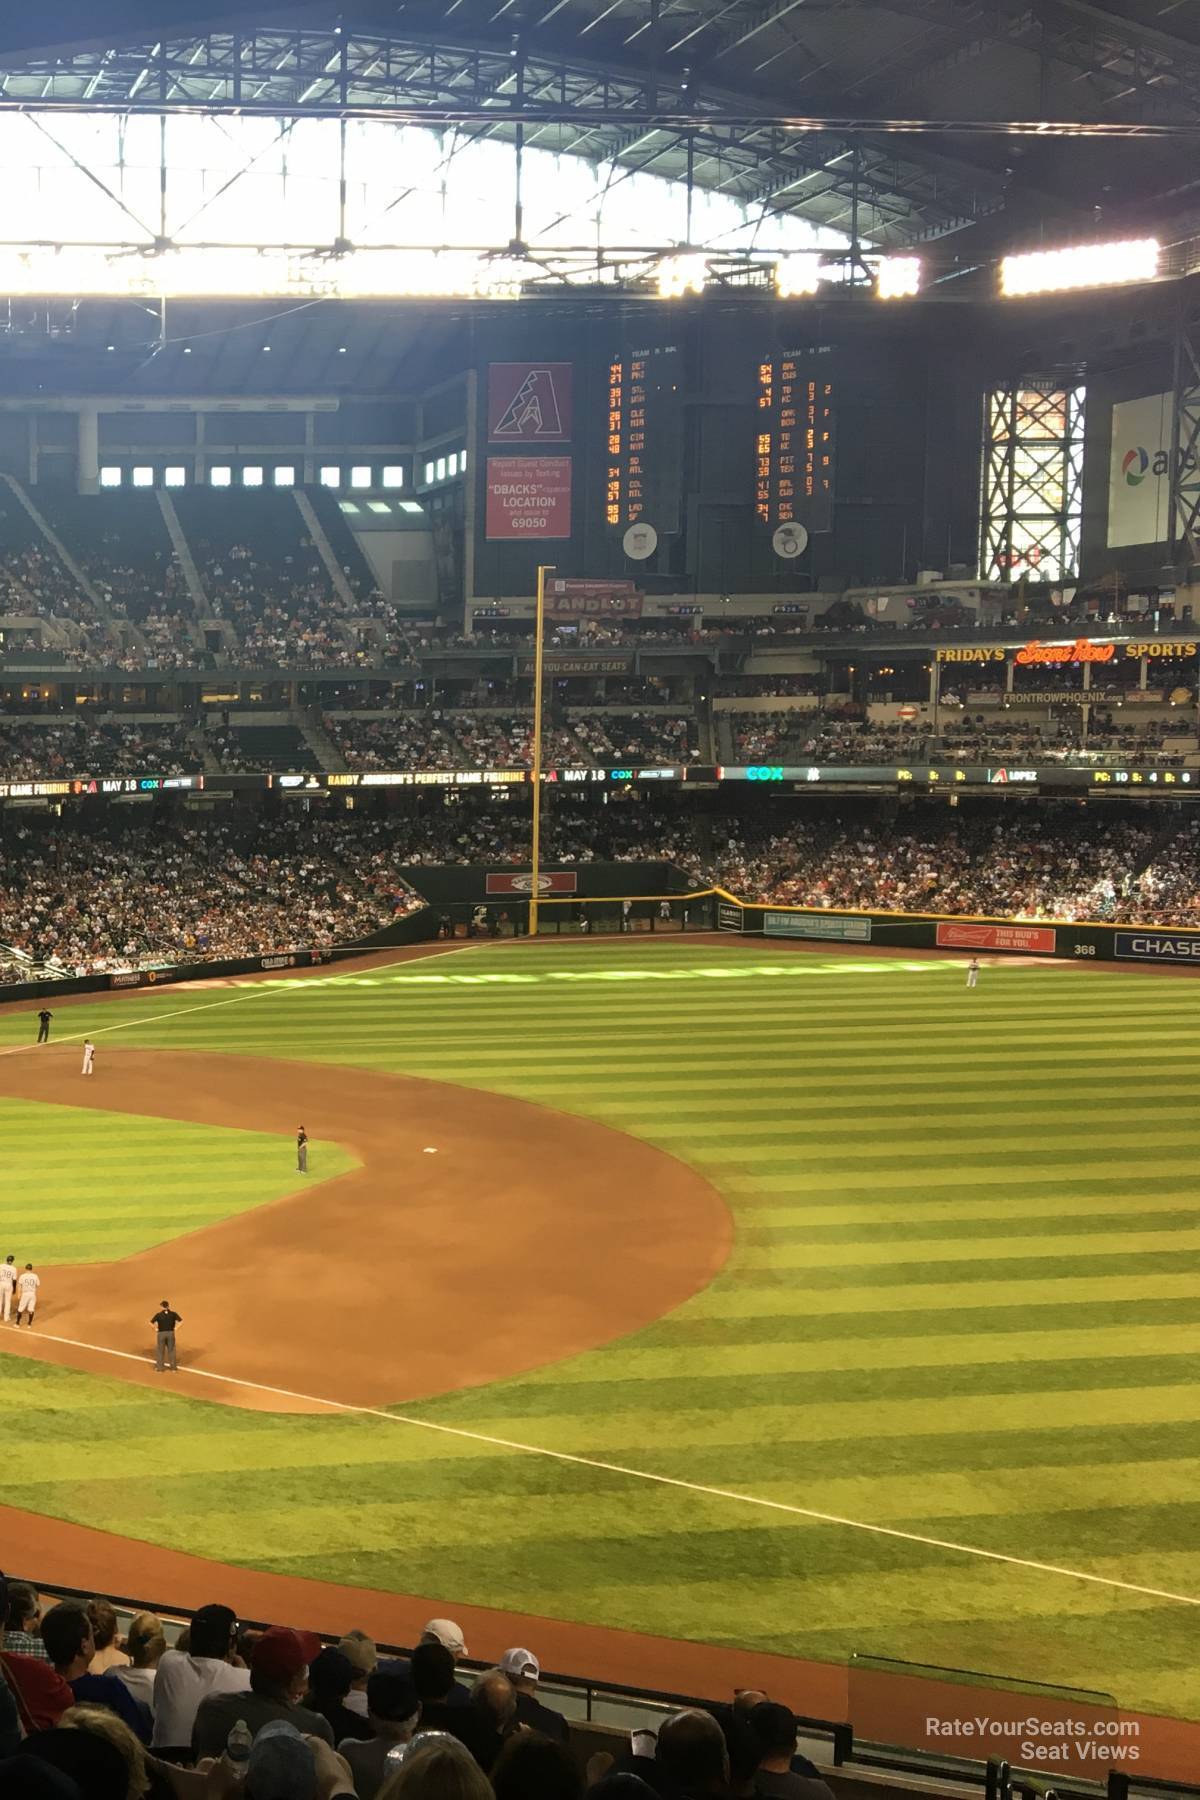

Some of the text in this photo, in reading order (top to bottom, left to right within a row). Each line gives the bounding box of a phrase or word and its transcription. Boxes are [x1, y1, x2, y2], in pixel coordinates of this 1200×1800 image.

[610, 374, 621, 384] 27
[760, 374, 771, 384] 46
[760, 397, 771, 407] 57
[780, 456, 794, 464] PIT
[608, 491, 619, 500] 57
[503, 497, 556, 507] LOCATION
[512, 518, 546, 528] 69050
[936, 647, 1005, 661] FRIDAYS
[1126, 643, 1197, 656] SPORTS
[328, 774, 359, 786] RANDY
[361, 773, 413, 785] JOHNSON'S
[415, 773, 455, 784] PERFECT
[456, 772, 482, 783] GAME
[483, 771, 526, 783] FIGURINE
[564, 769, 588, 782] MAY
[592, 769, 606, 781] 18
[611, 769, 633, 780] COX
[746, 767, 784, 781] COX
[897, 769, 913, 781] PC:
[1009, 771, 1037, 781] LOPEZ
[1094, 772, 1111, 782] PC:
[1115, 772, 1129, 782] 10
[1132, 772, 1142, 782] S:
[1149, 772, 1158, 783] 4
[1165, 772, 1176, 783] B:
[10, 783, 33, 796] GAME
[34, 782, 70, 795] FIGURINE
[102, 780, 122, 792] MAY
[125, 780, 137, 791] 18
[141, 780, 159, 790] COX
[995, 929, 1039, 939] THIS BUD'S
[995, 938, 1011, 946] FOR
[1132, 939, 1200, 956] CHASE
[1074, 944, 1096, 955] 368
